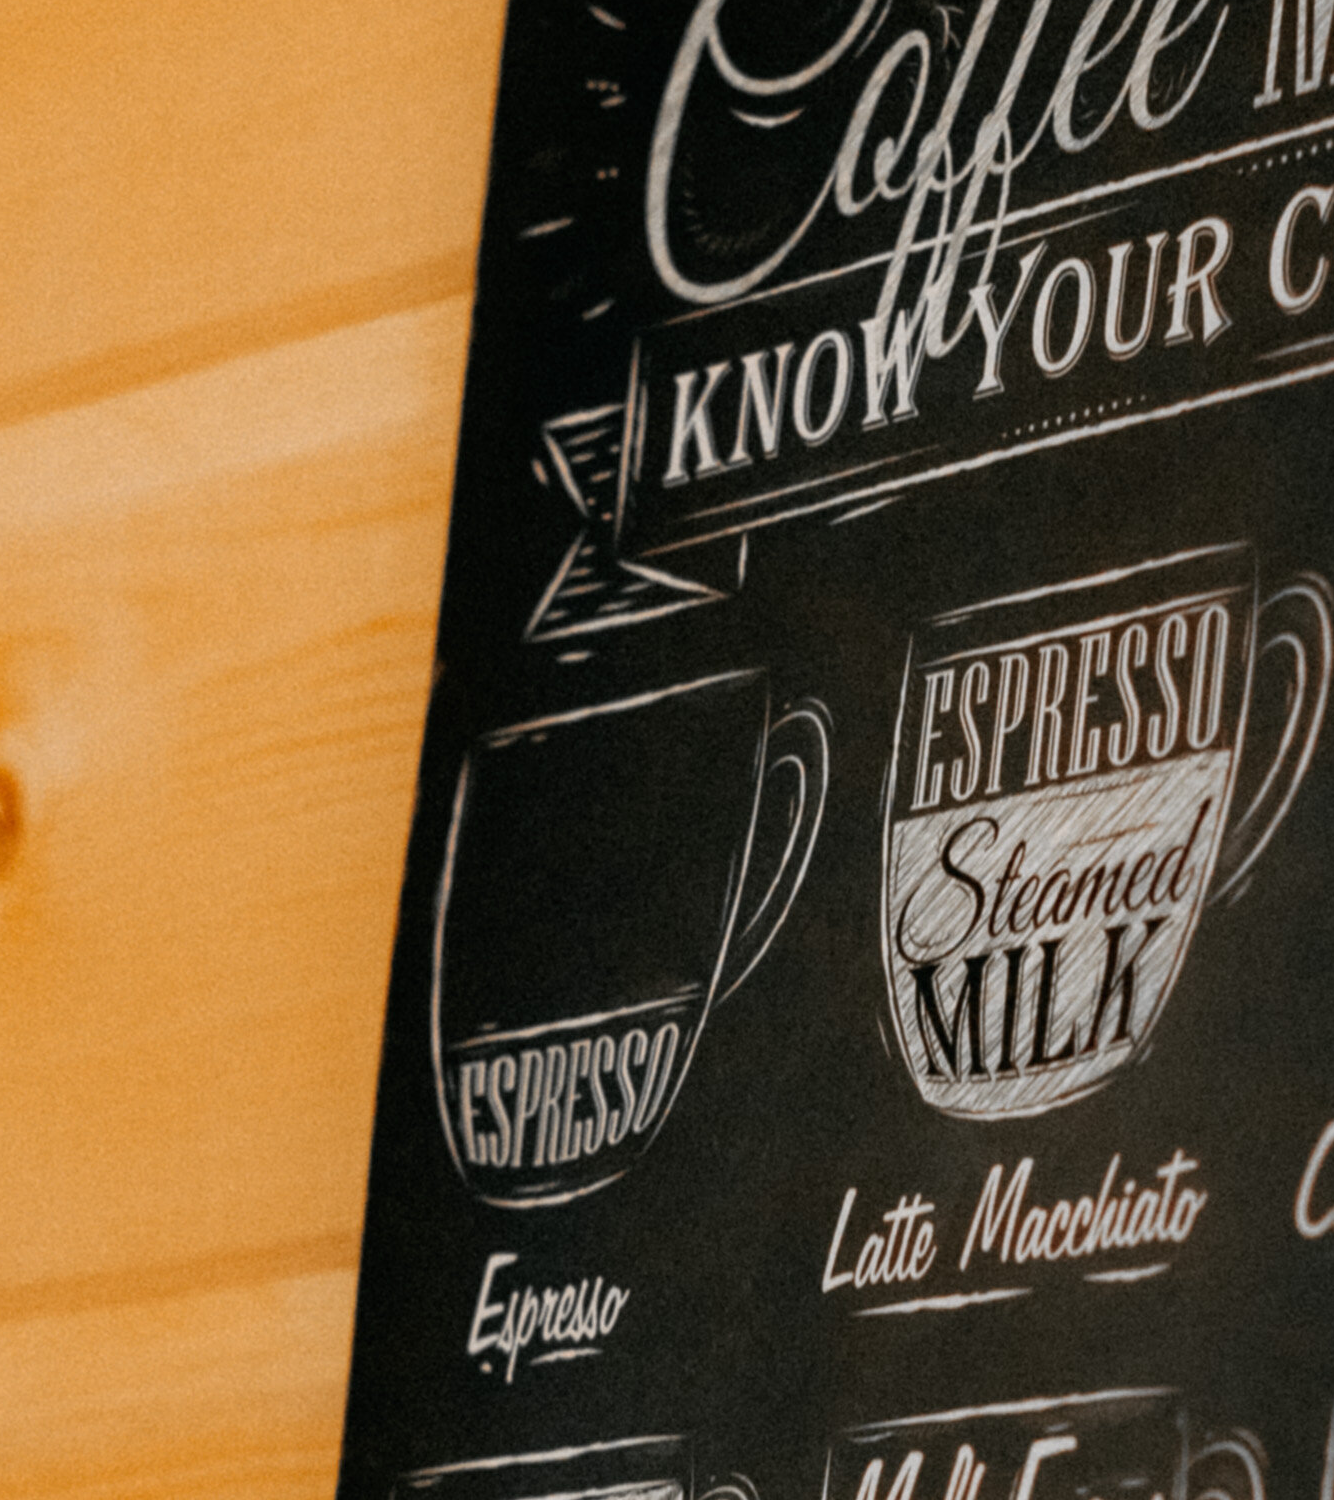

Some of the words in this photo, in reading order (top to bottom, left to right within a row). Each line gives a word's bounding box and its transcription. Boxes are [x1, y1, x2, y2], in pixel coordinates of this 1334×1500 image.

[663, 310, 919, 488] KNOW
[969, 217, 1233, 400] YOUR
[910, 604, 1230, 811] ESPRESSO
[897, 797, 1213, 963] Steamed
[908, 916, 1170, 1085] MILK
[458, 1022, 680, 1169] ESPRESSO
[822, 1187, 937, 1294] Latte
[959, 1148, 1208, 1272] Macchiato
[467, 1252, 630, 1385] Espresso
